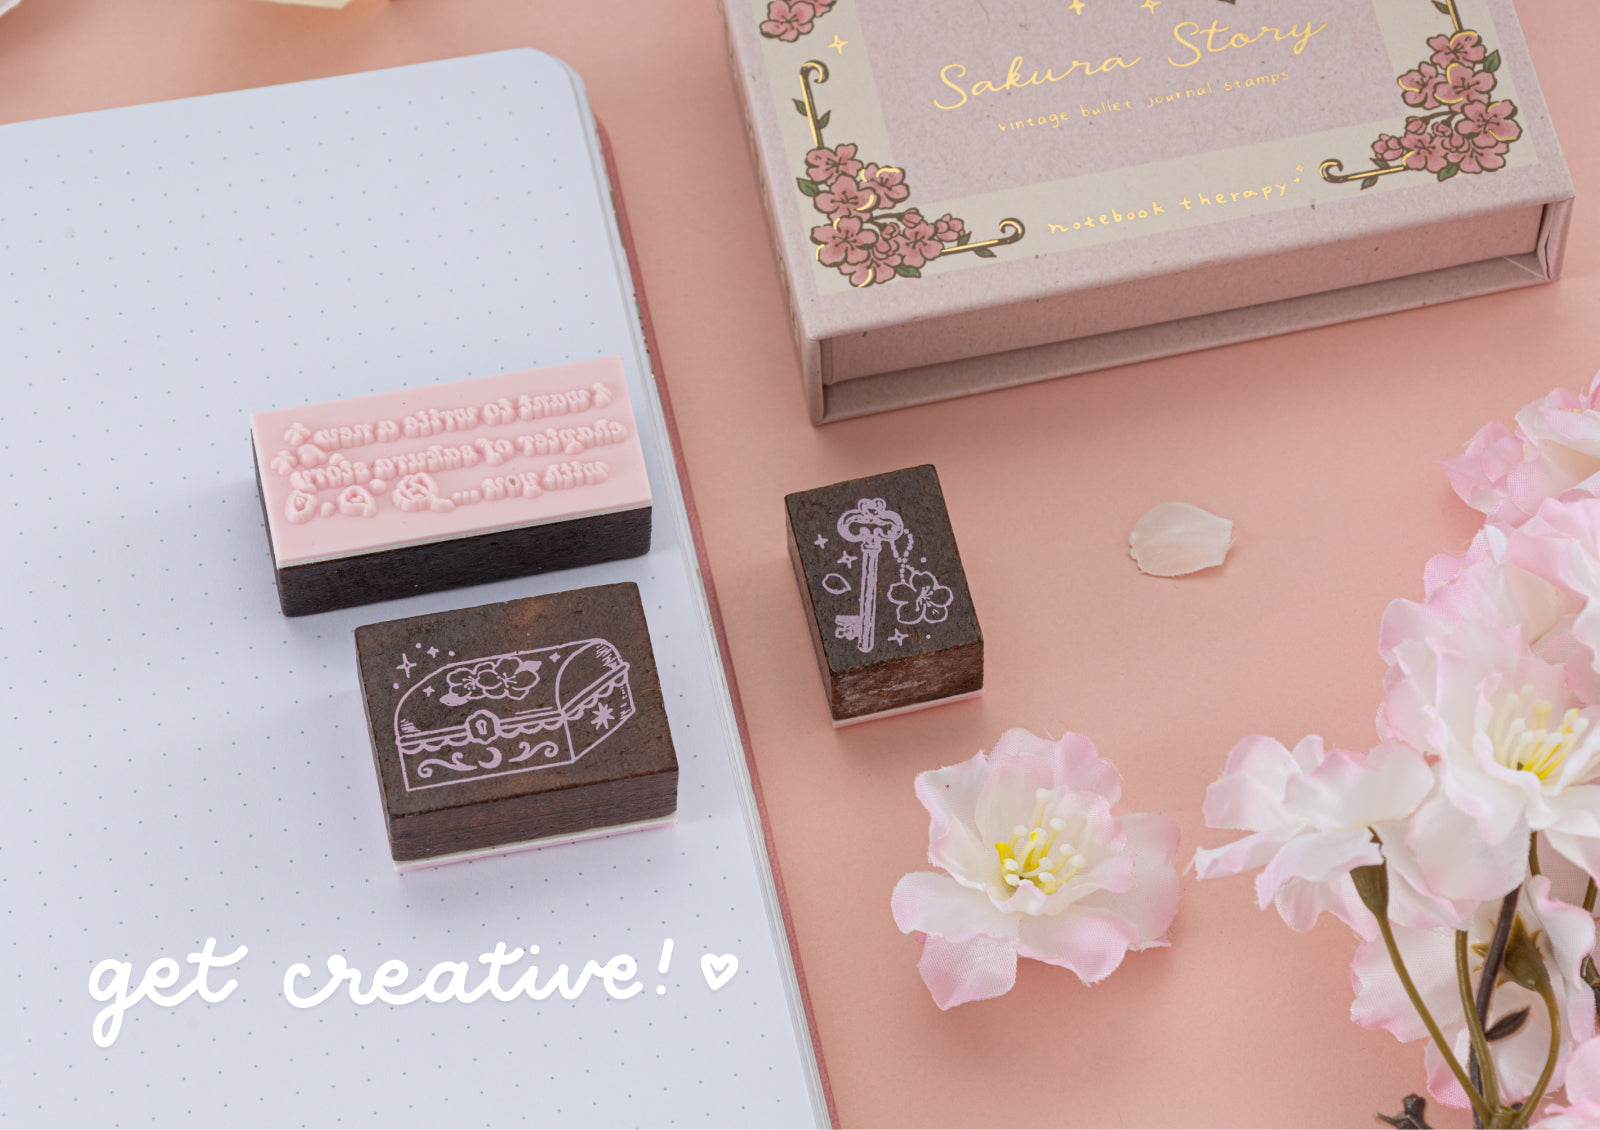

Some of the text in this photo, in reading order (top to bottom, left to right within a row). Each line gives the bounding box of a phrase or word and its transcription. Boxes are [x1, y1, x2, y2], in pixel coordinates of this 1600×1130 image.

[933, 19, 1329, 110] Sakura Story
[998, 69, 1290, 132] vintage bullet journal stamps
[1047, 182, 1288, 234] notebook therapy
